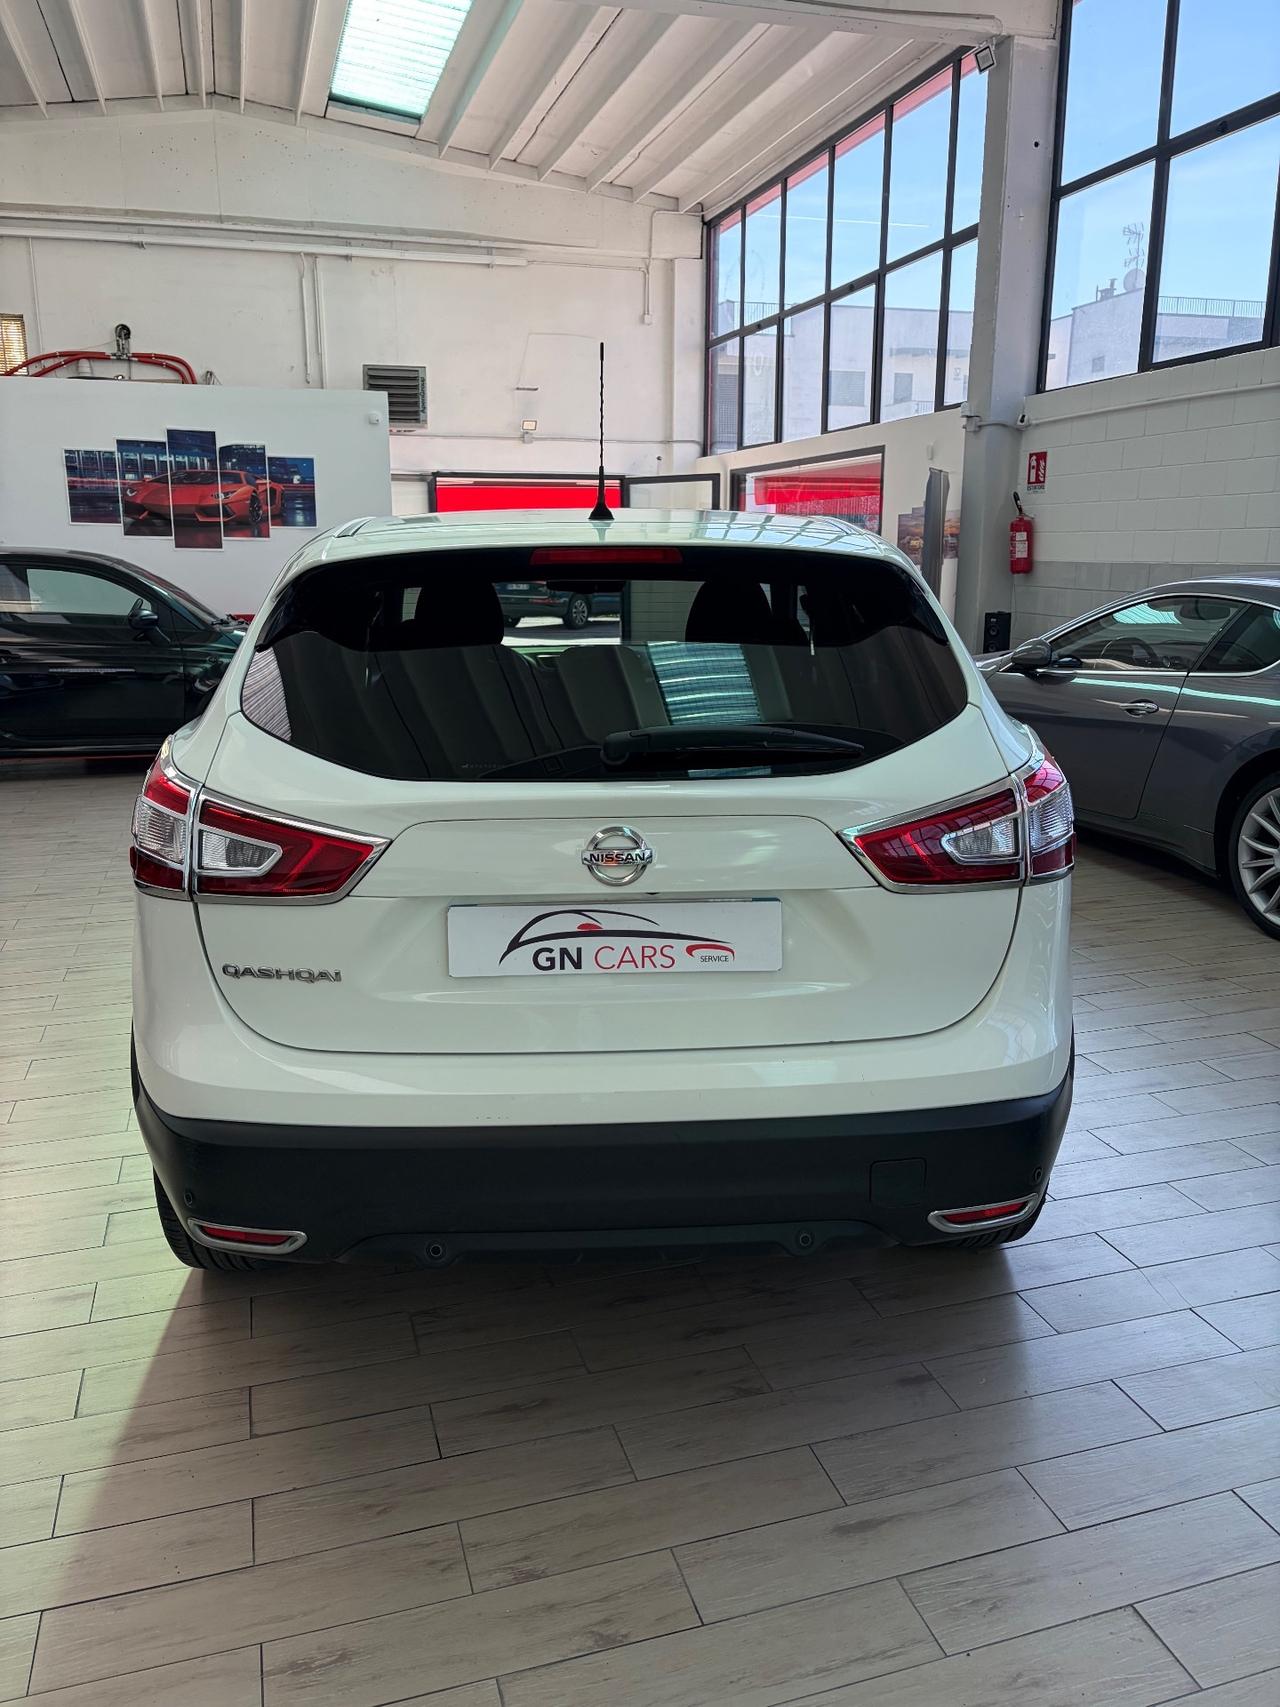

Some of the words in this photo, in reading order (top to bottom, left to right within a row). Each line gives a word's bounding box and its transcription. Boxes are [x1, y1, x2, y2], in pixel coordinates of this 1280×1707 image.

[589, 853, 645, 862] NISSAN
[532, 947, 582, 971] GN
[594, 945, 676, 970] CARS
[221, 963, 342, 983] QASHQAI
